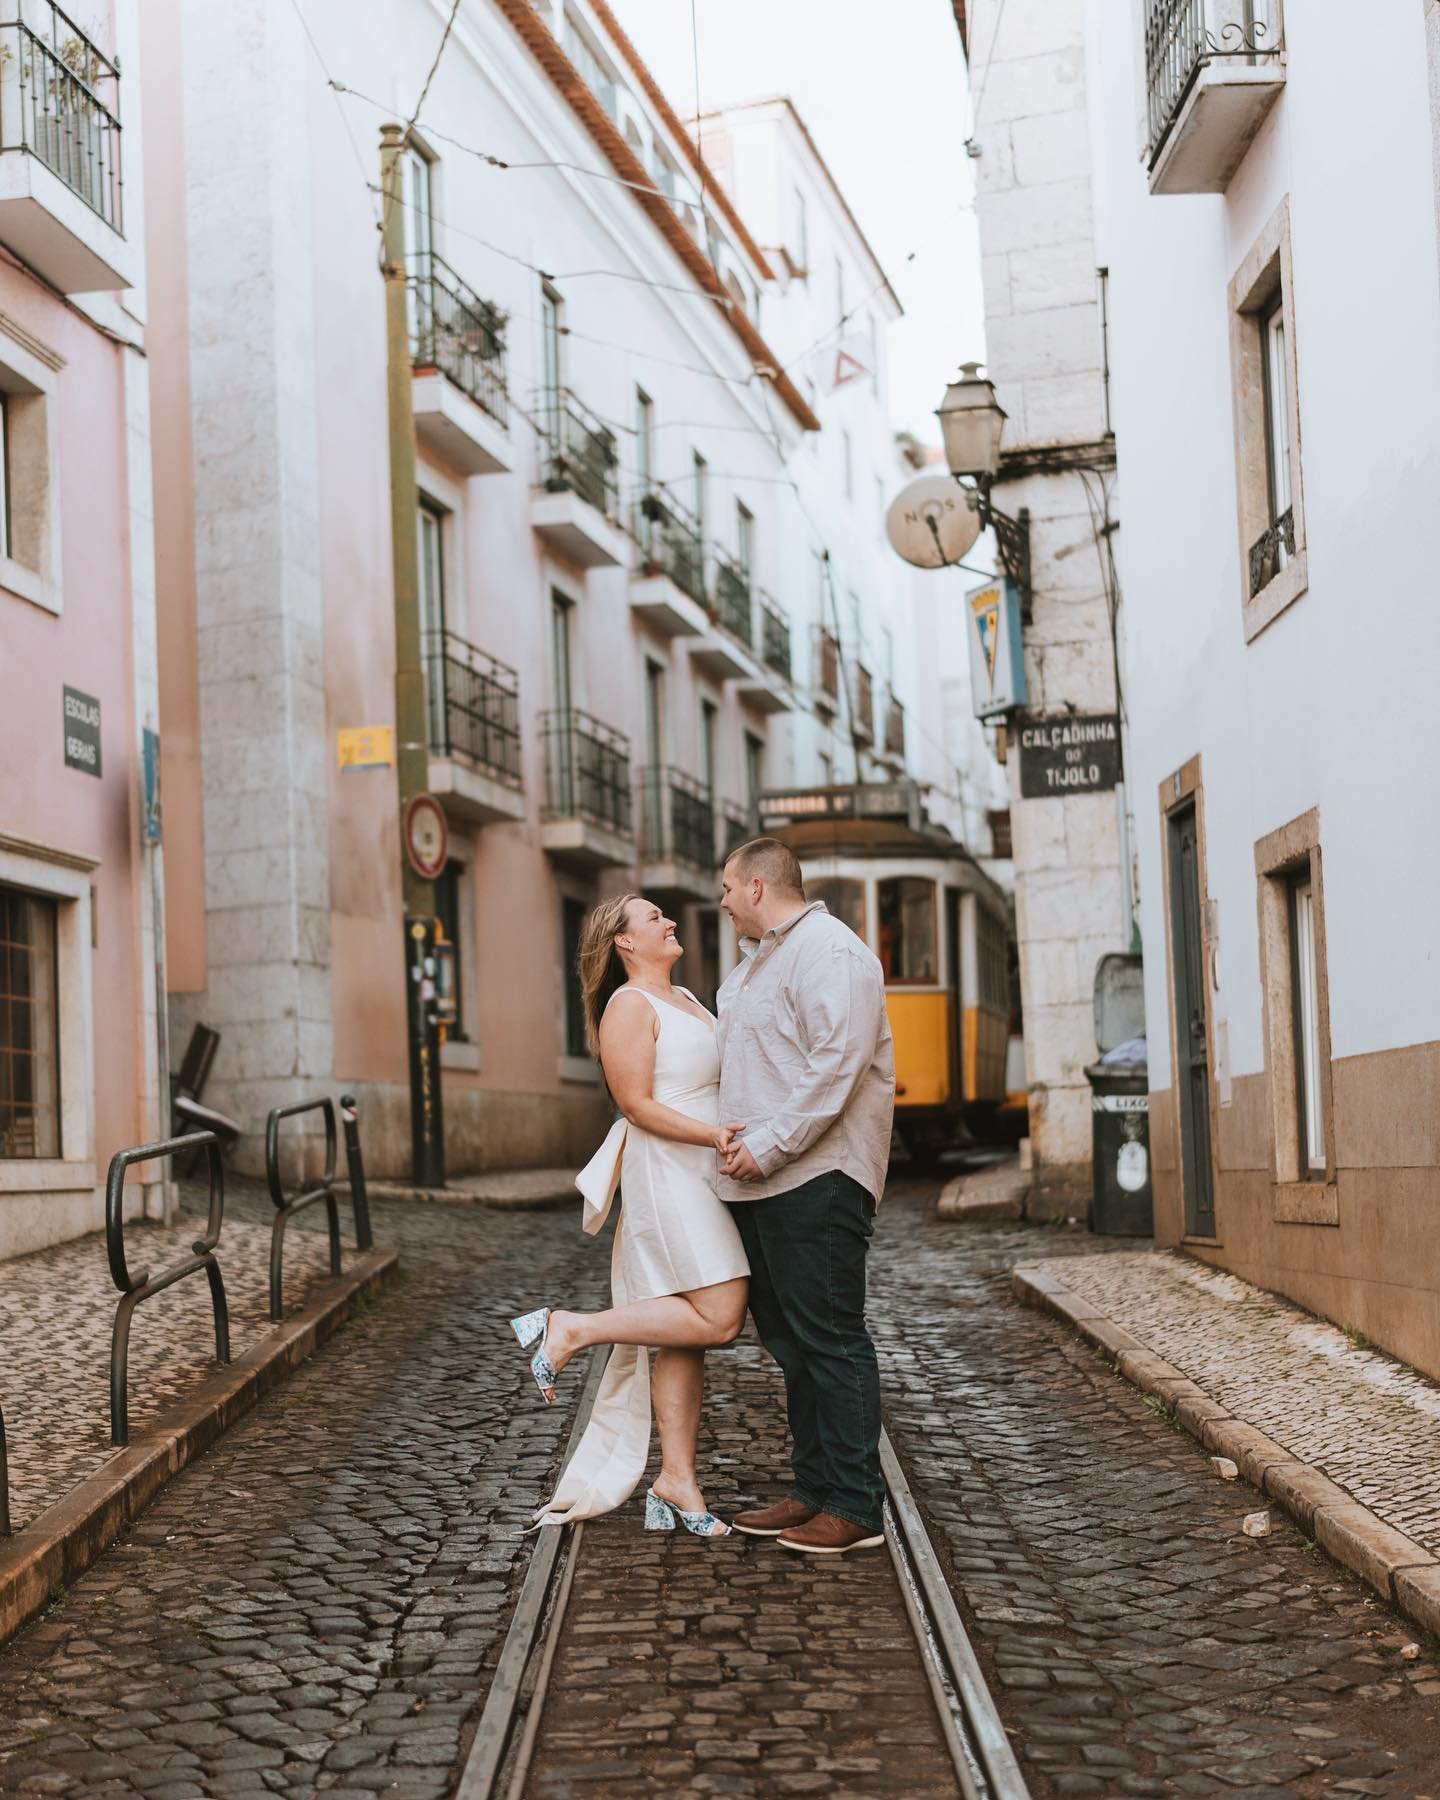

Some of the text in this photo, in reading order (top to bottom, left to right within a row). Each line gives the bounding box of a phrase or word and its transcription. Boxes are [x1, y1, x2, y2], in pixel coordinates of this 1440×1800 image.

[65, 695, 99, 727] ESCOLAS
[1022, 721, 1116, 750] CALÇADINHA
[67, 736, 96, 765] GERAIS
[1046, 764, 1100, 787] TIJOLO
[1115, 1097, 1148, 1109] LIXO
